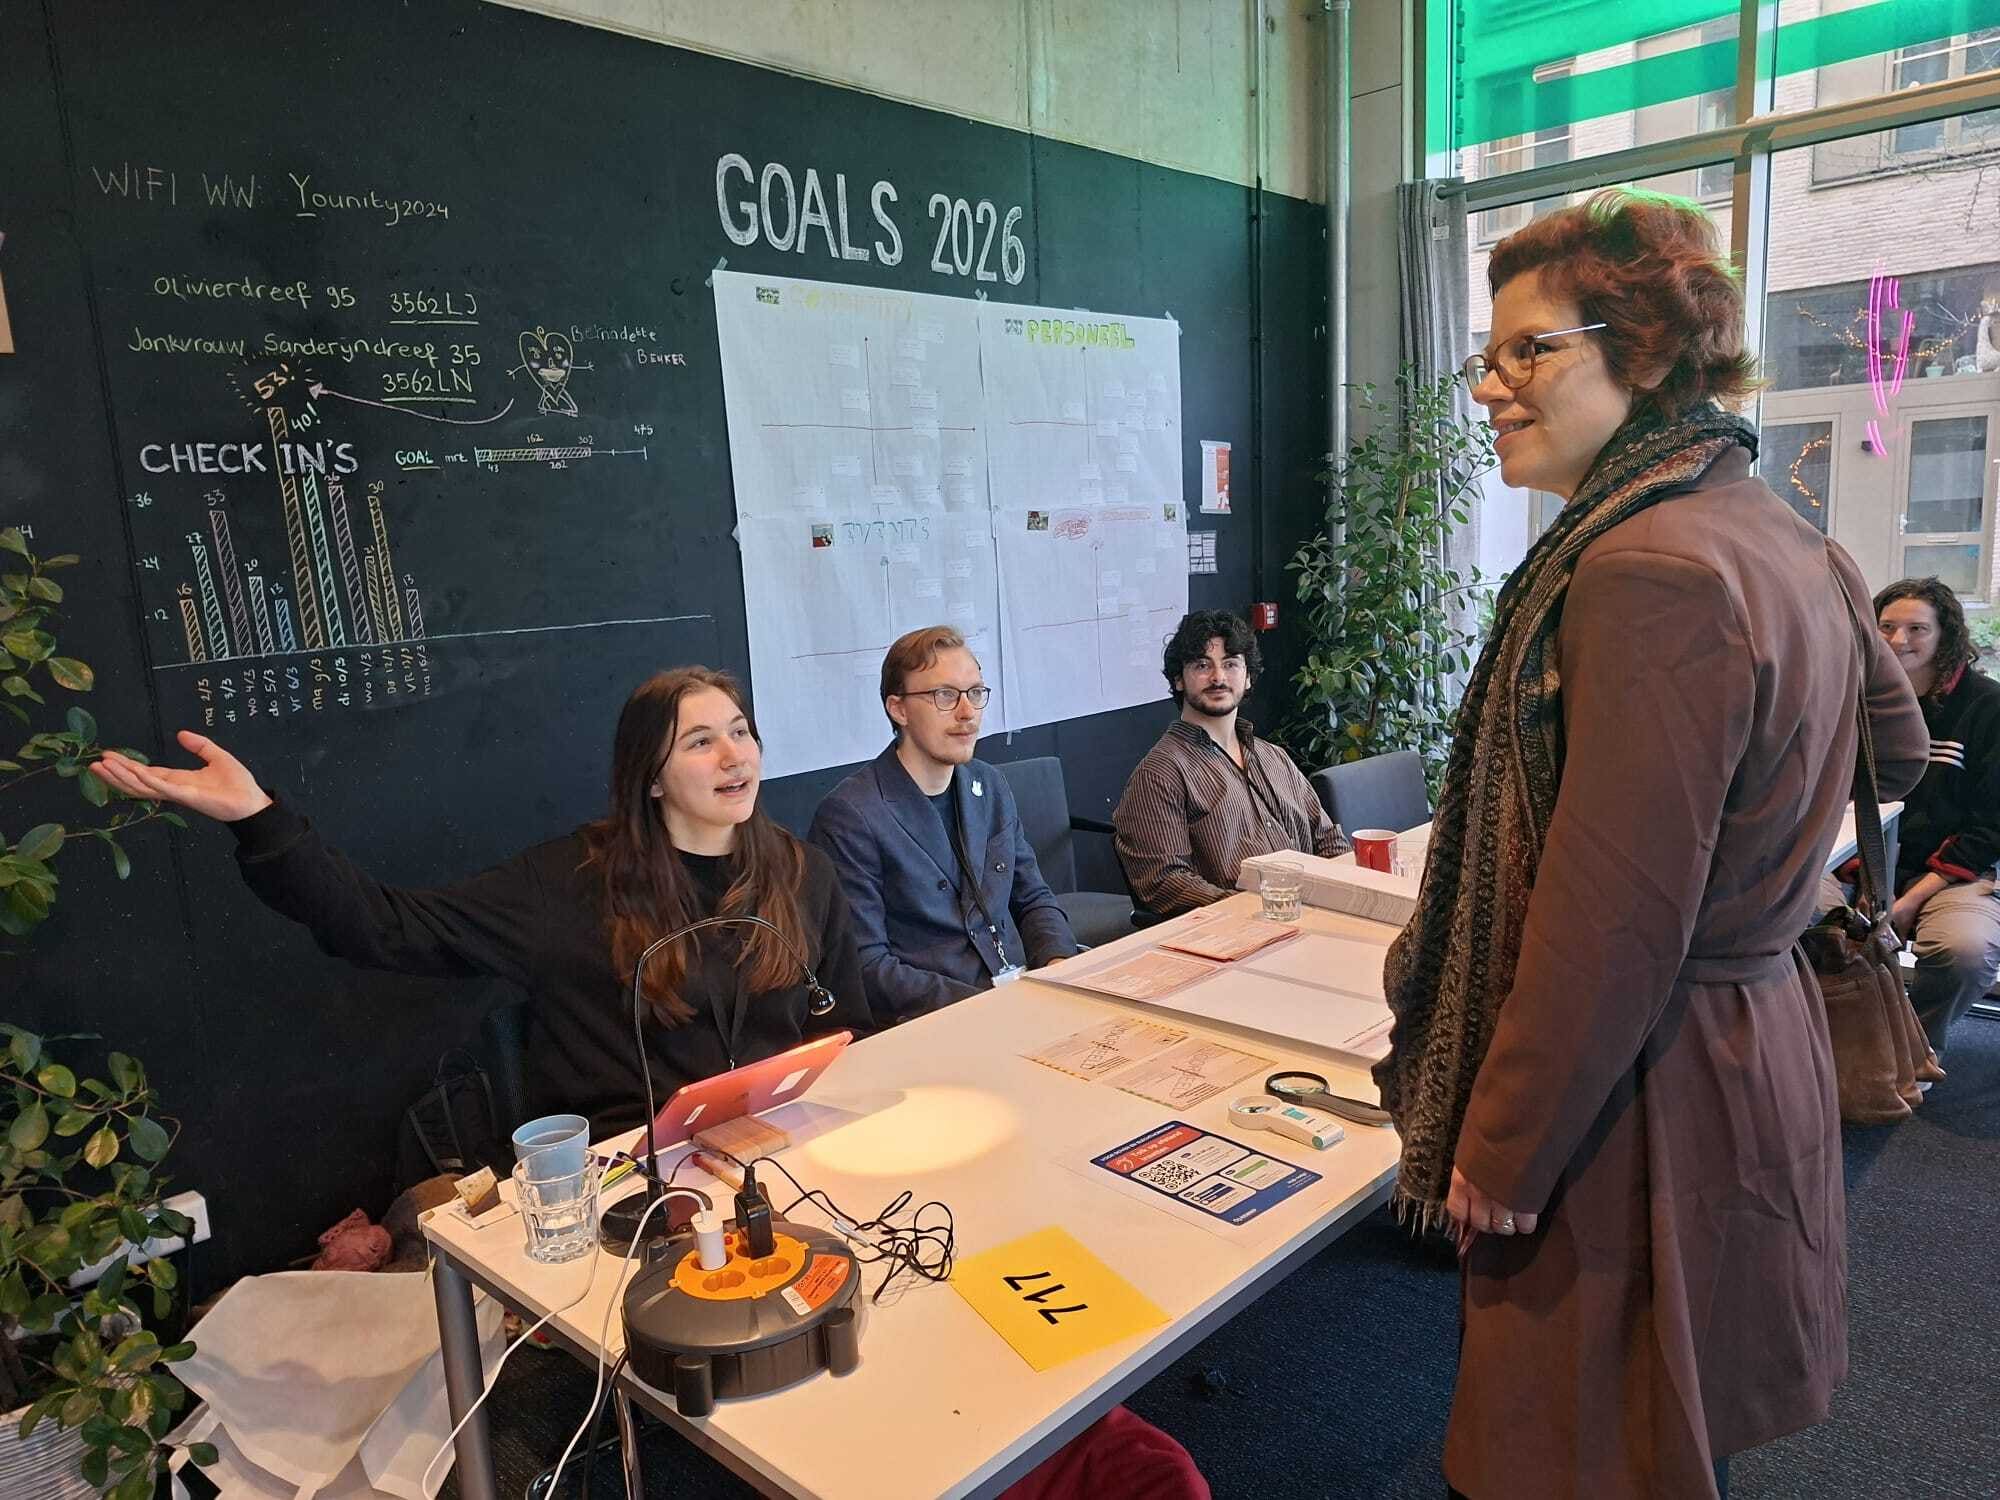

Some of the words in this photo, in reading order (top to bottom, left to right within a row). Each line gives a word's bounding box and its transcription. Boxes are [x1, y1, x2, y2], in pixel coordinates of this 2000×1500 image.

[93, 161, 176, 206] WIFI
[716, 152, 904, 267] GOALS
[928, 193, 1026, 286] 2026
[326, 286, 356, 309] 95
[450, 344, 480, 366] 35
[383, 369, 472, 394] 3562LN
[291, 401, 321, 433] 40!
[139, 443, 266, 474] CHECK
[395, 449, 434, 466] GOAL
